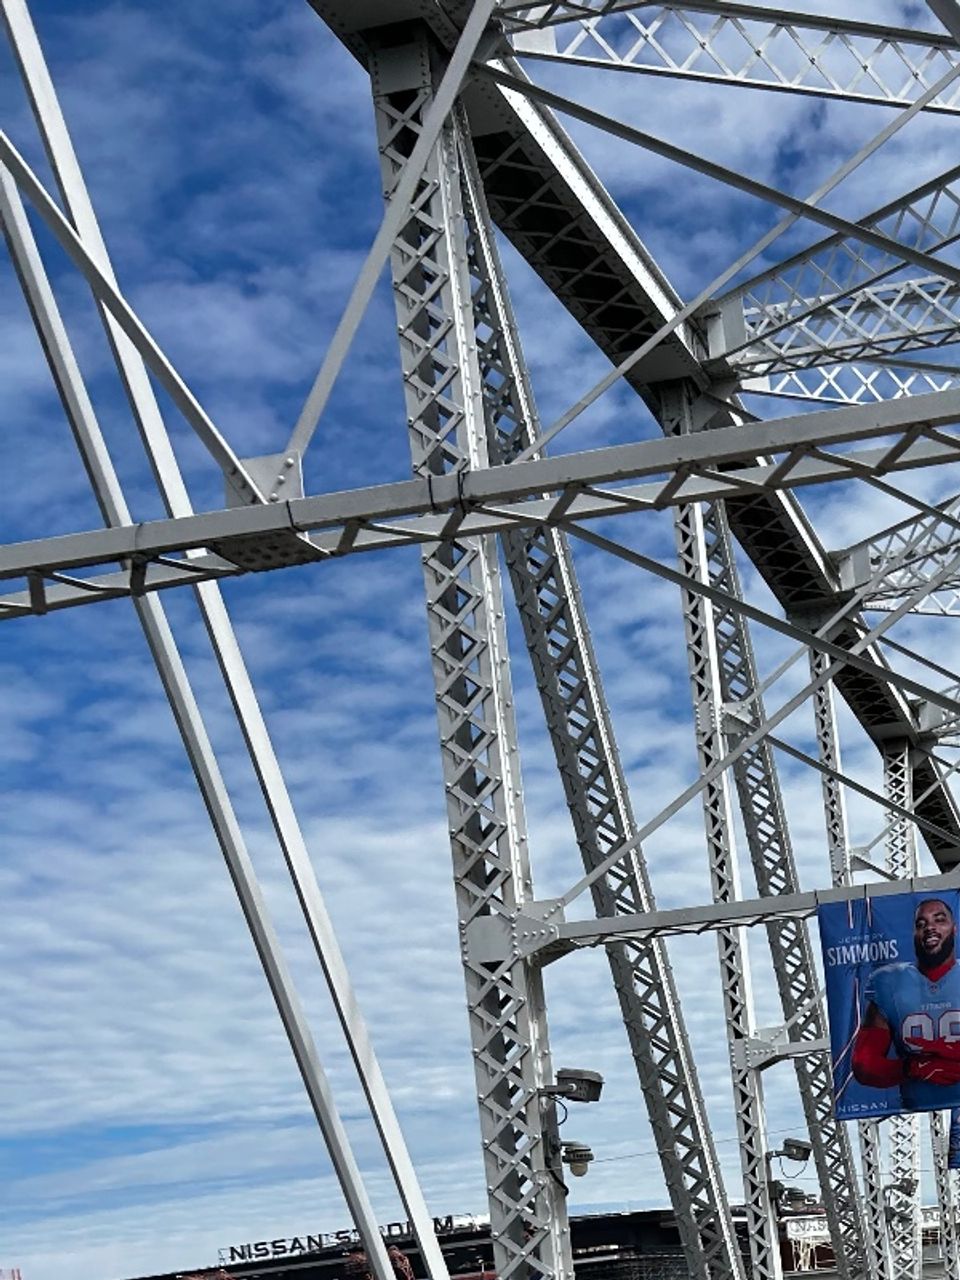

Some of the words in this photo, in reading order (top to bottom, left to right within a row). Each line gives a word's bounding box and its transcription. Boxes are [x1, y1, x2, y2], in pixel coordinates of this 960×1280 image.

[827, 939, 899, 967] SIMMONS
[838, 1101, 889, 1115] NISSAN
[229, 1233, 323, 1262] NISSAN
